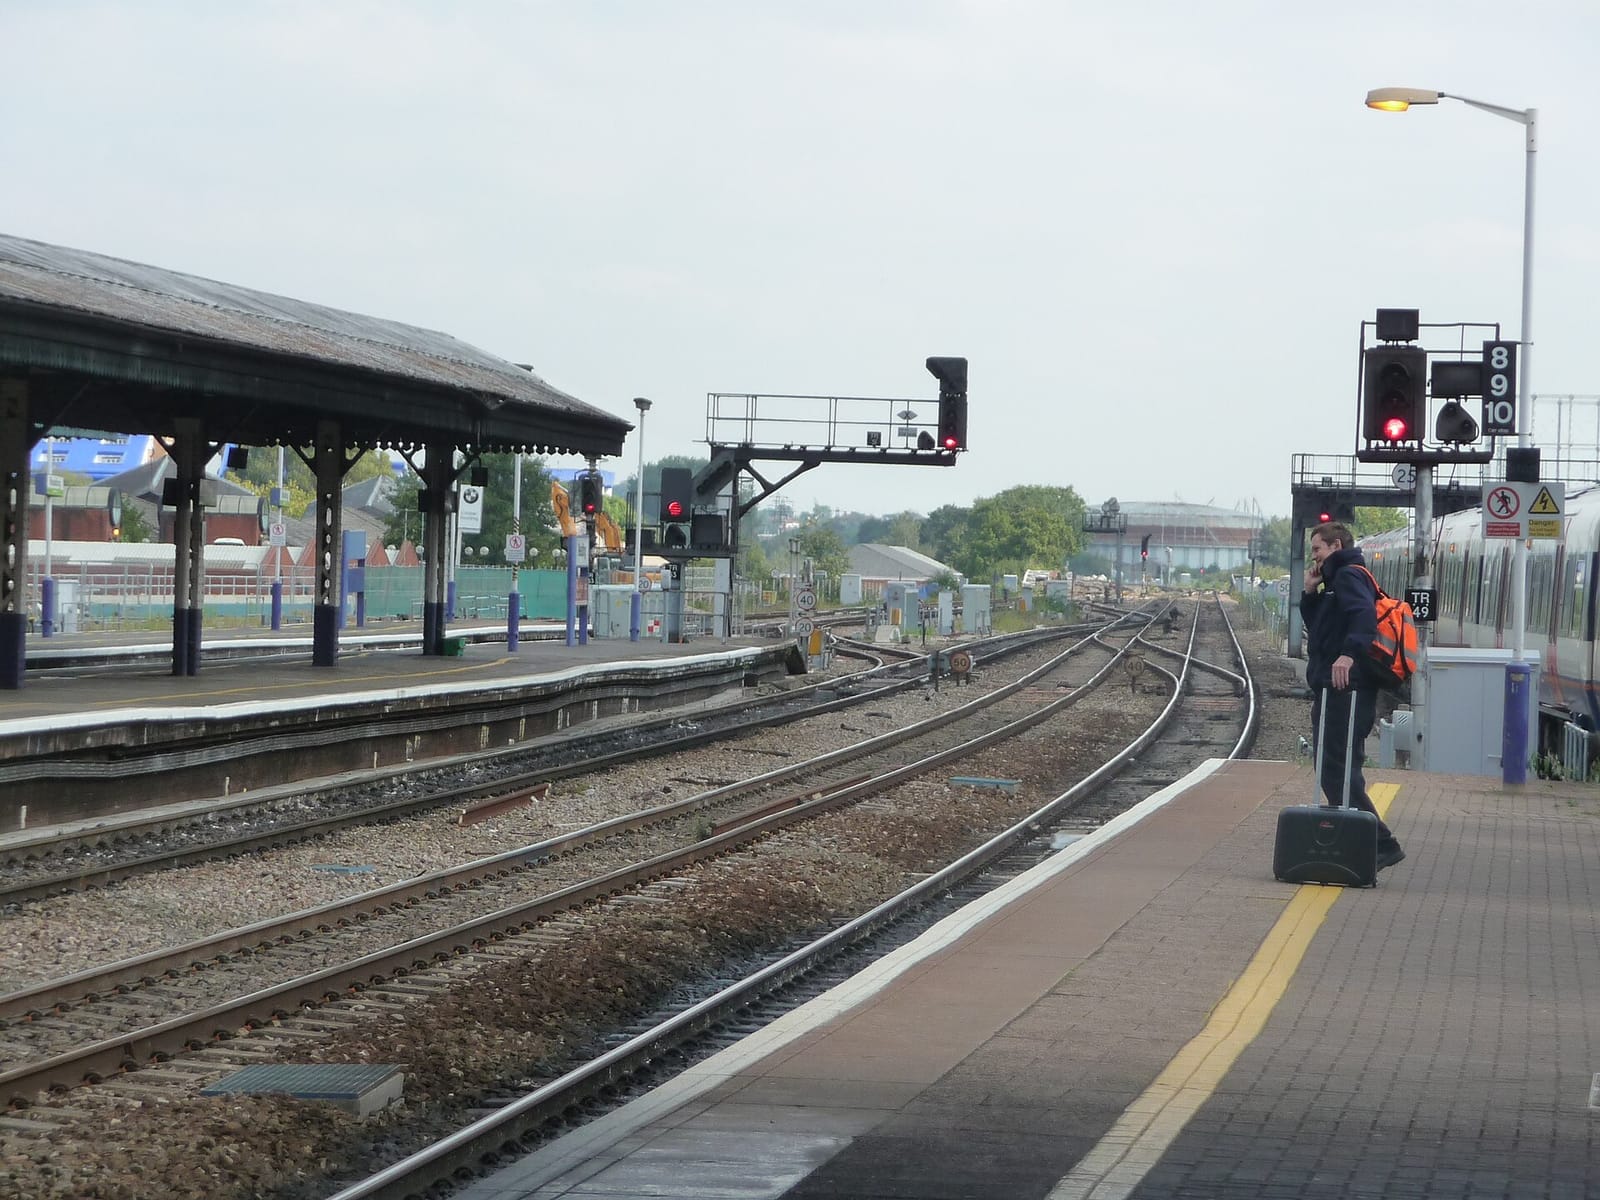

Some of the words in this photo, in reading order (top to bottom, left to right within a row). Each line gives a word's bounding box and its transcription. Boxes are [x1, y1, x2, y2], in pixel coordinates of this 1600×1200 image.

[1491, 346, 1508, 369] 8
[1491, 373, 1508, 396] 9
[1485, 401, 1513, 424] 10
[1397, 468, 1416, 483] 25
[799, 595, 814, 605] 40
[1411, 592, 1430, 604] TR
[1412, 606, 1429, 618] 49
[799, 622, 812, 632] 20
[953, 657, 967, 667] 50
[1127, 661, 1142, 671] 40
